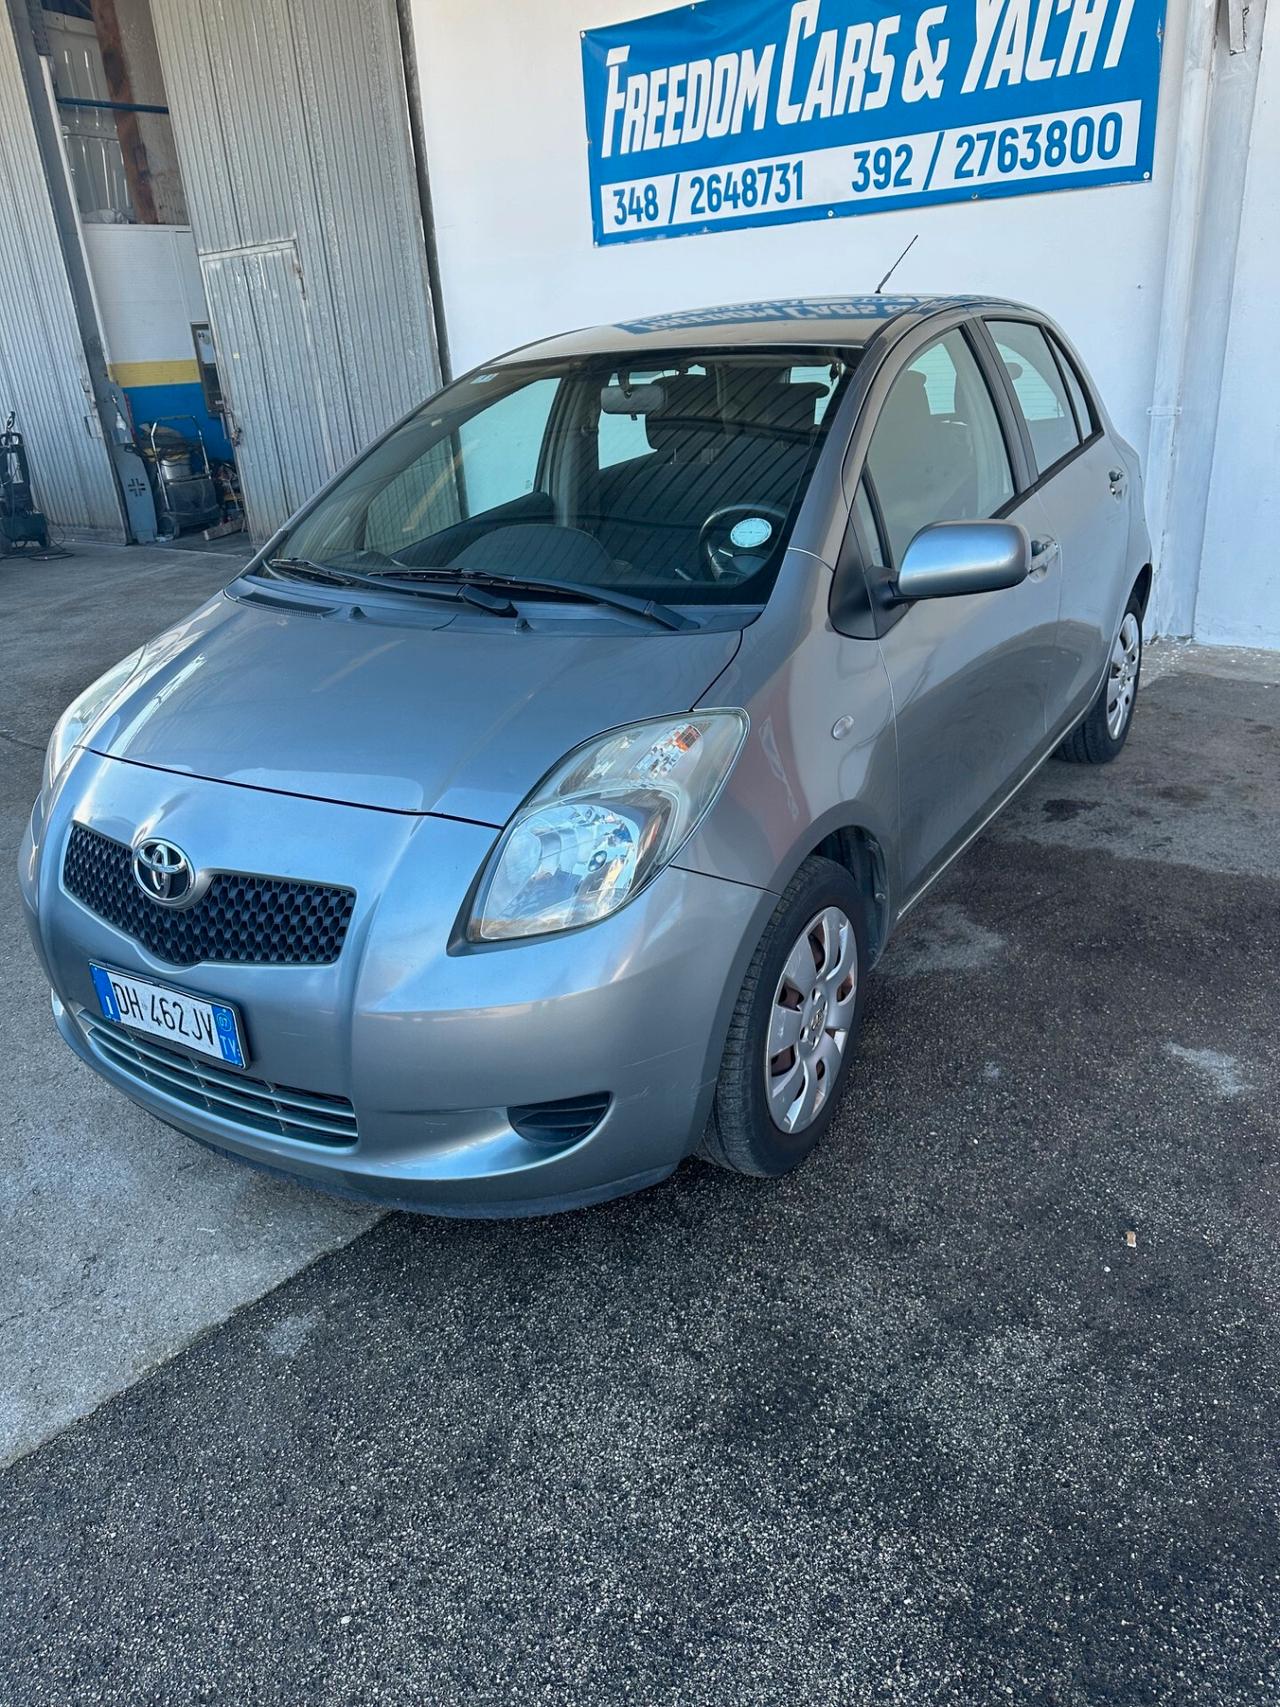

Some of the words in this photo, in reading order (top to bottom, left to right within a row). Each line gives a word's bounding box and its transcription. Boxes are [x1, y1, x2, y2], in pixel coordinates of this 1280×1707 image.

[601, 44, 776, 158] FREEDOM
[776, 0, 901, 126] CARS
[901, 5, 950, 104] &
[613, 183, 660, 226] 348
[668, 173, 681, 225] /
[690, 159, 804, 216] 2648731
[852, 143, 913, 192] 392
[922, 131, 945, 191] /
[954, 111, 1123, 180] 2763800
[112, 981, 144, 1022] DH
